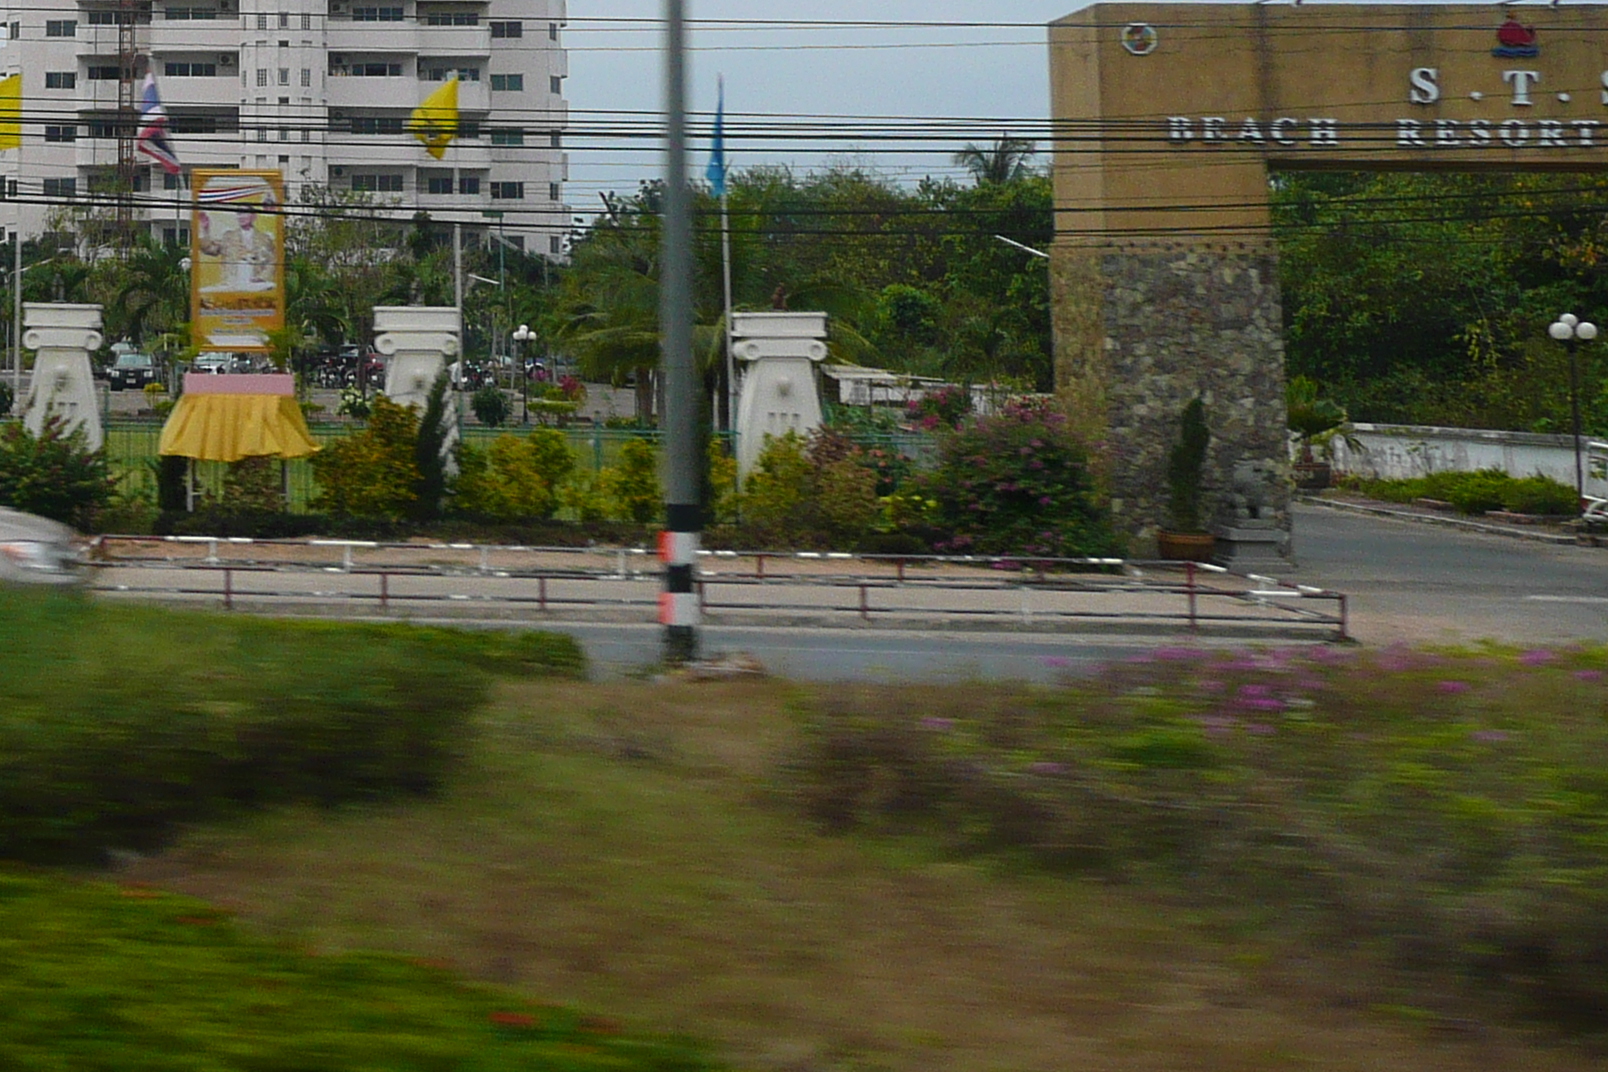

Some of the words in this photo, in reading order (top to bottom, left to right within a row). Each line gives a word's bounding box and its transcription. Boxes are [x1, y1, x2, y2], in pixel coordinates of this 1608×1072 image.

[1410, 67, 1608, 106] S.T.
[1166, 116, 1339, 145] BEACH
[1395, 118, 1600, 146] RESORT
